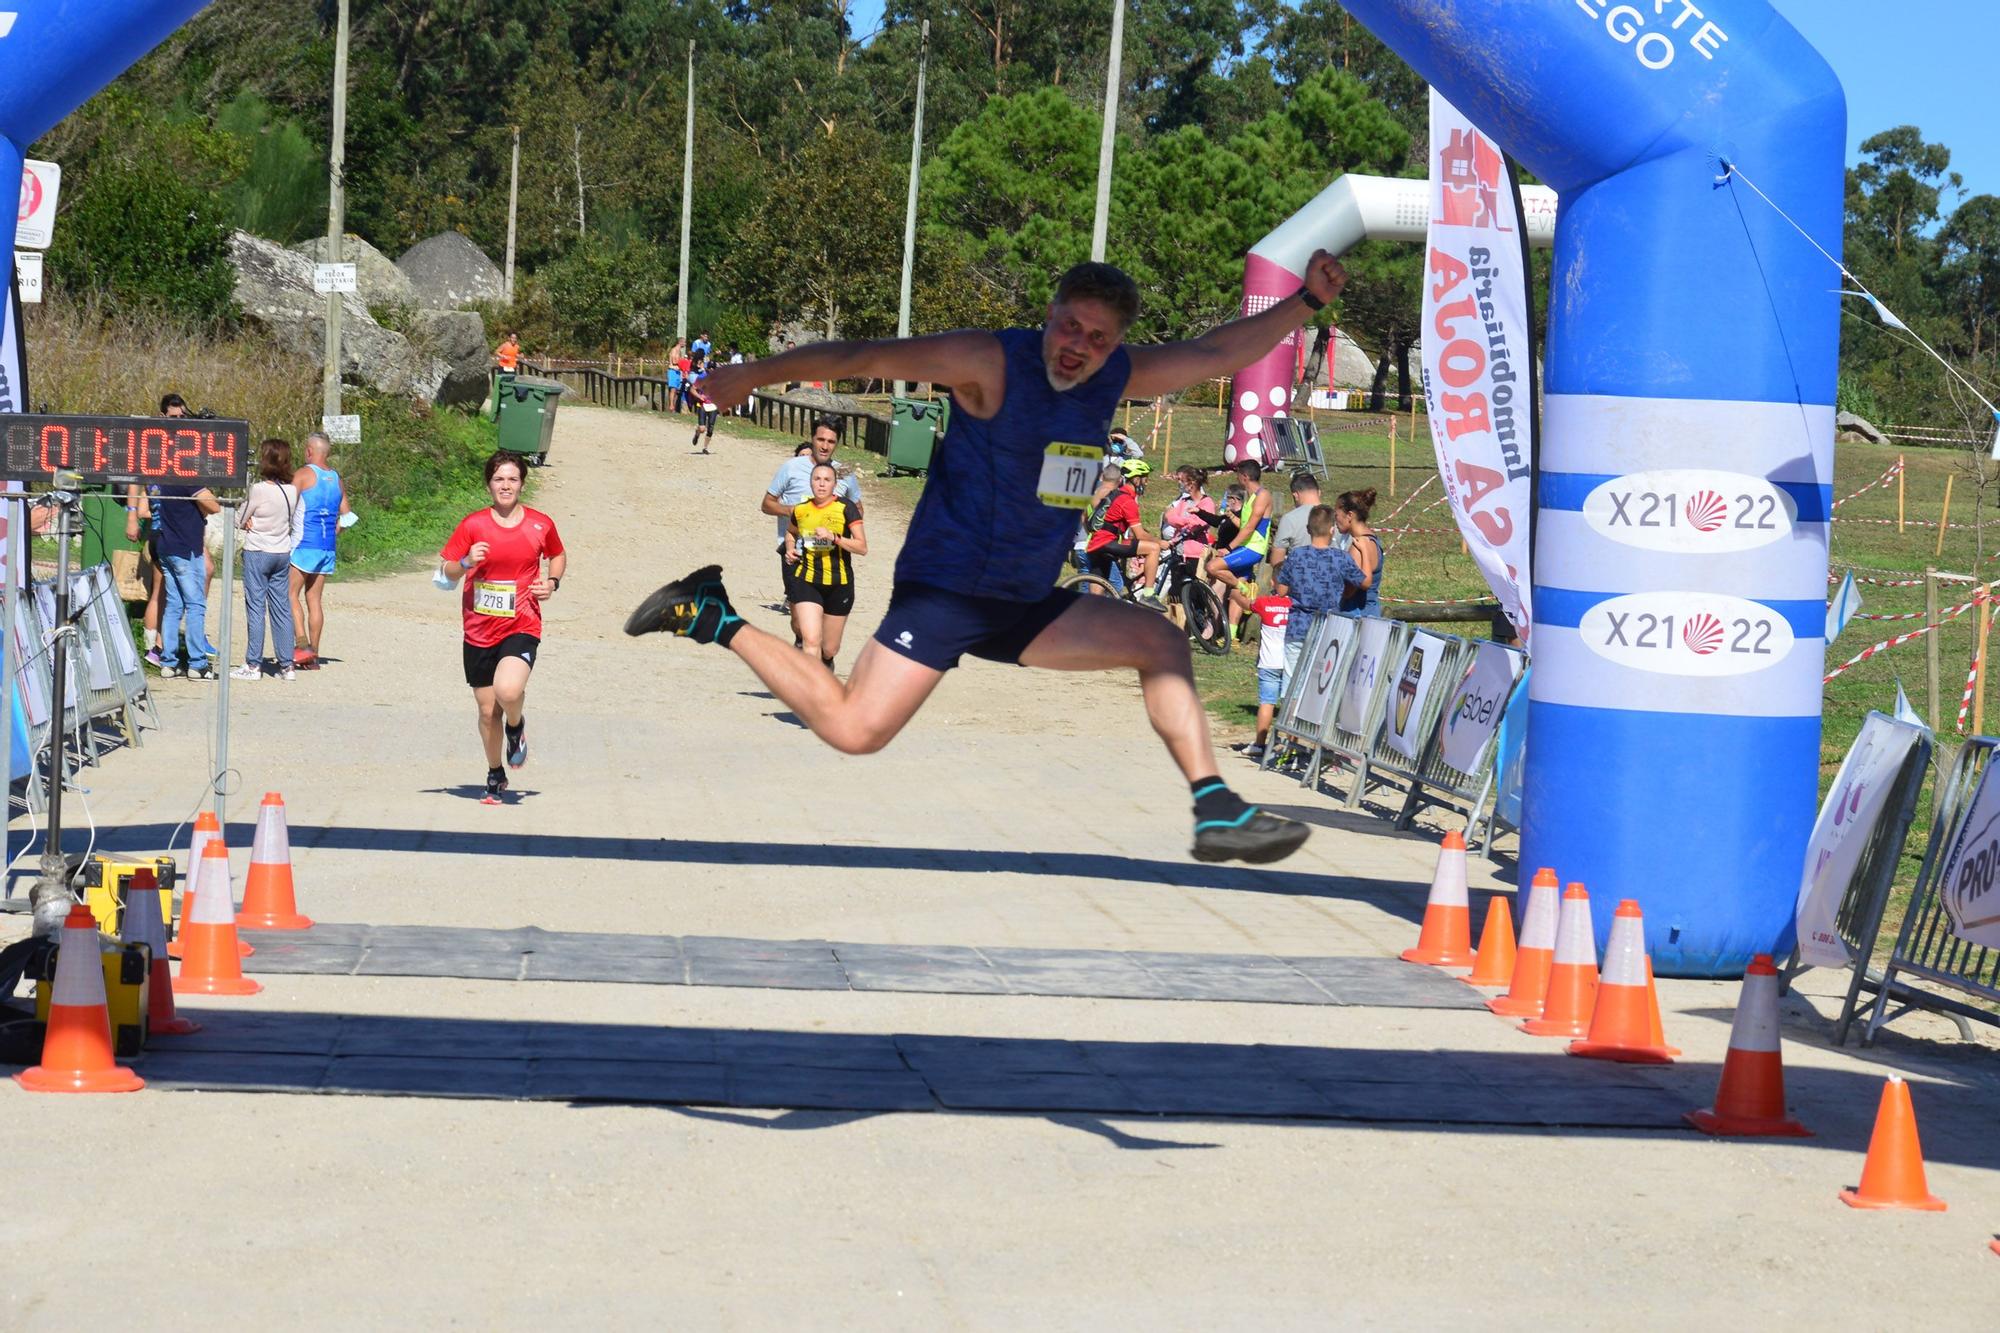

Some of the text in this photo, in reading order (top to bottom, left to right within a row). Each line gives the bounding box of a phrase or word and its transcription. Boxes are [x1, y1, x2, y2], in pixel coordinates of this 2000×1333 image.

[40, 424, 235, 477] 01:10:24
[1065, 466, 1086, 493] 171
[484, 594, 503, 609] 278
[1958, 838, 2000, 912] PRO
